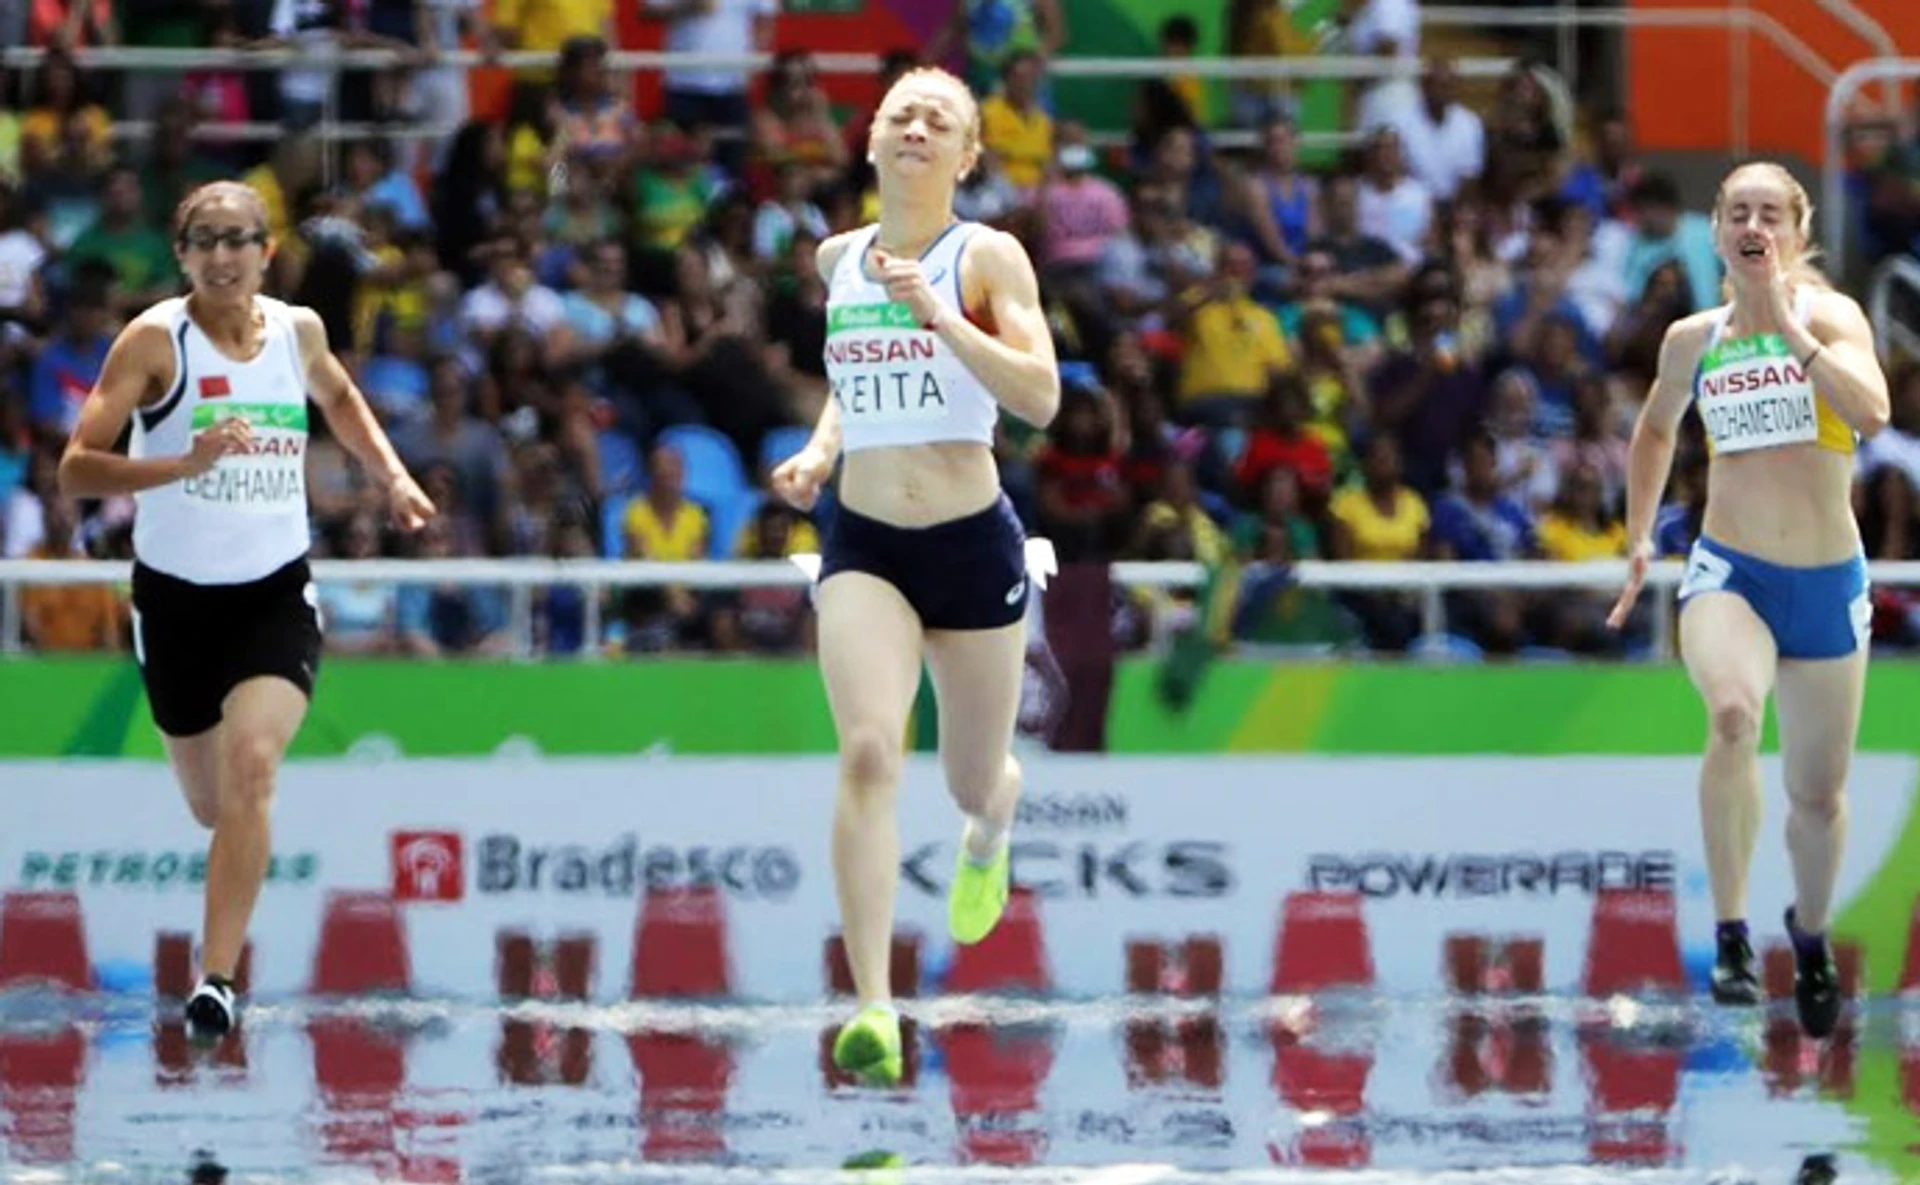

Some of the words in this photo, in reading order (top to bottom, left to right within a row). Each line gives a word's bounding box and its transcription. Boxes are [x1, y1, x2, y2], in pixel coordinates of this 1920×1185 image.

[1702, 364, 1808, 396] NISSAN
[477, 831, 801, 899] Bradesco
[901, 840, 1238, 896] KCKS
[1306, 850, 1674, 898] POWERADE
